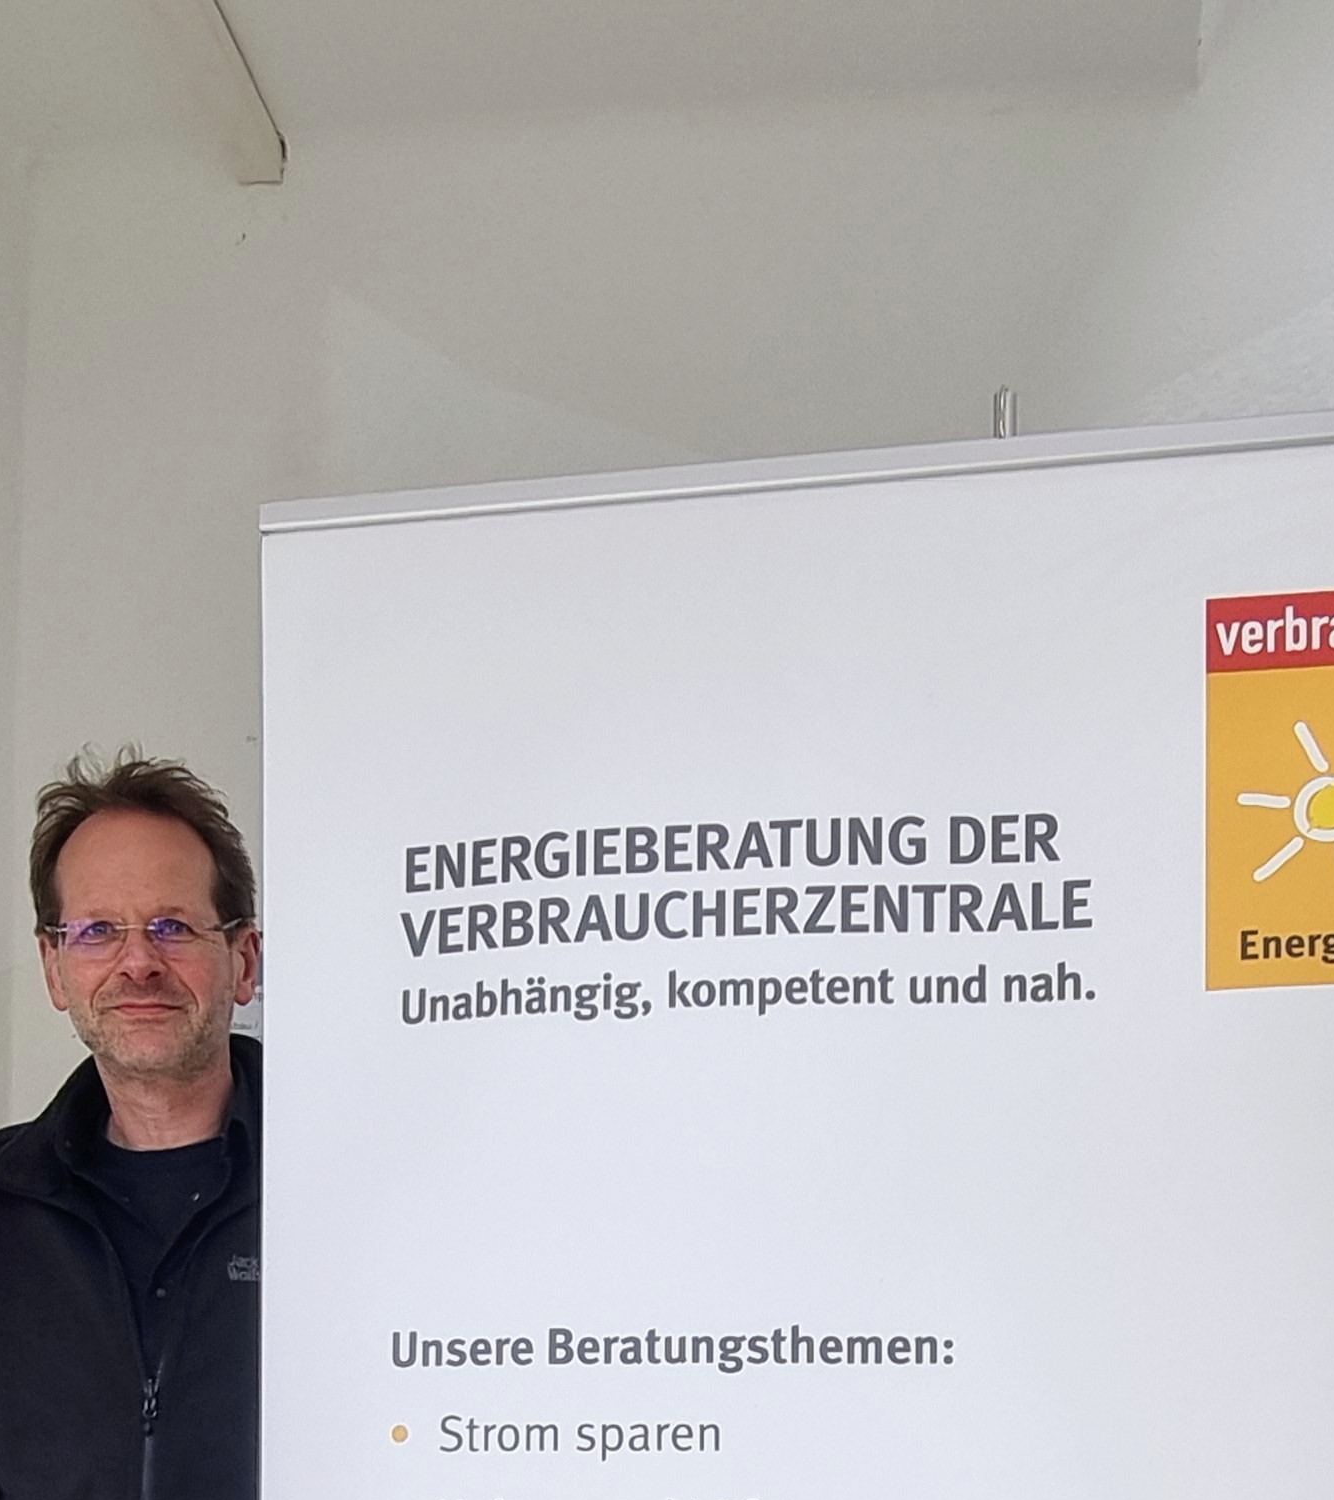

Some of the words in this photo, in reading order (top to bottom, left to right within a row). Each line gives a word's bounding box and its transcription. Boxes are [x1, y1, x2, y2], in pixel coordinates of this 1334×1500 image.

[403, 816, 928, 895] ENERGIEBERATUNG
[949, 813, 1061, 865] DER
[398, 878, 1095, 958] VERBRAUCHERZENTRALE
[402, 972, 652, 1025] Unabhängig,
[668, 968, 895, 1017] kompetent
[909, 963, 987, 1005] und
[1003, 961, 1096, 1003] nah.
[392, 1331, 534, 1368] Unsere
[548, 1324, 954, 1374] Beratungsthemen:
[439, 1414, 559, 1453] Strom
[576, 1423, 720, 1462] sparen
